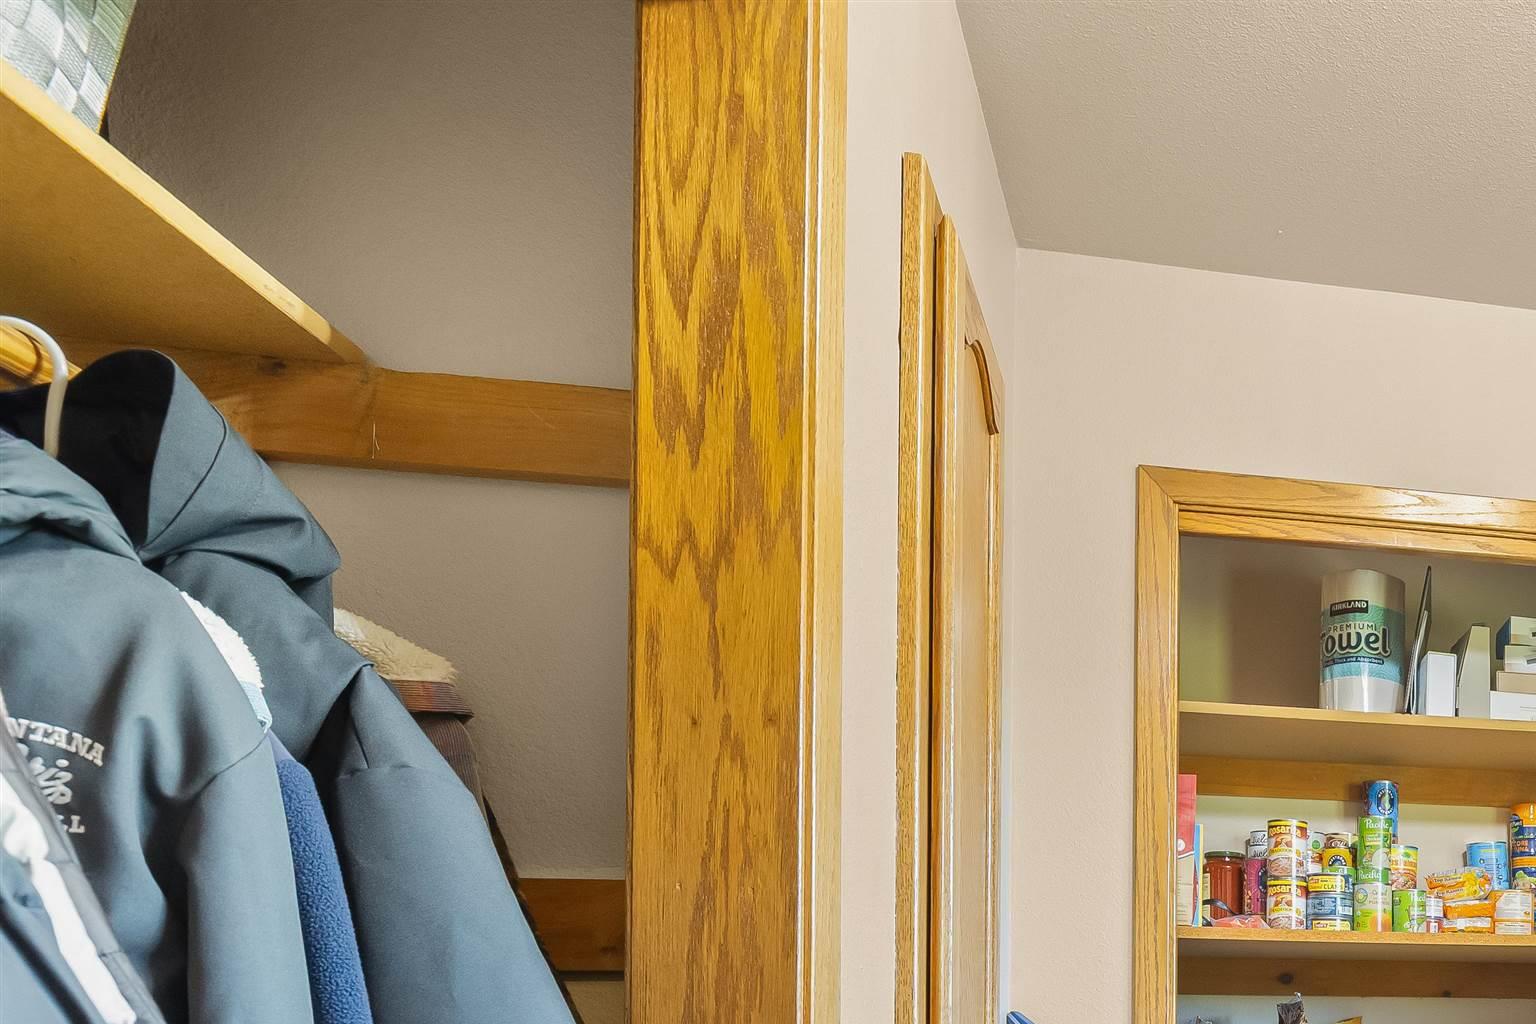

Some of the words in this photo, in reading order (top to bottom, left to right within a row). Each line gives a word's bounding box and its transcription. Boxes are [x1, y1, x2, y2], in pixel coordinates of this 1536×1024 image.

[1321, 627, 1390, 656] owel
[1328, 622, 1377, 633] PREMIUM
[6, 716, 105, 767] NTANA
